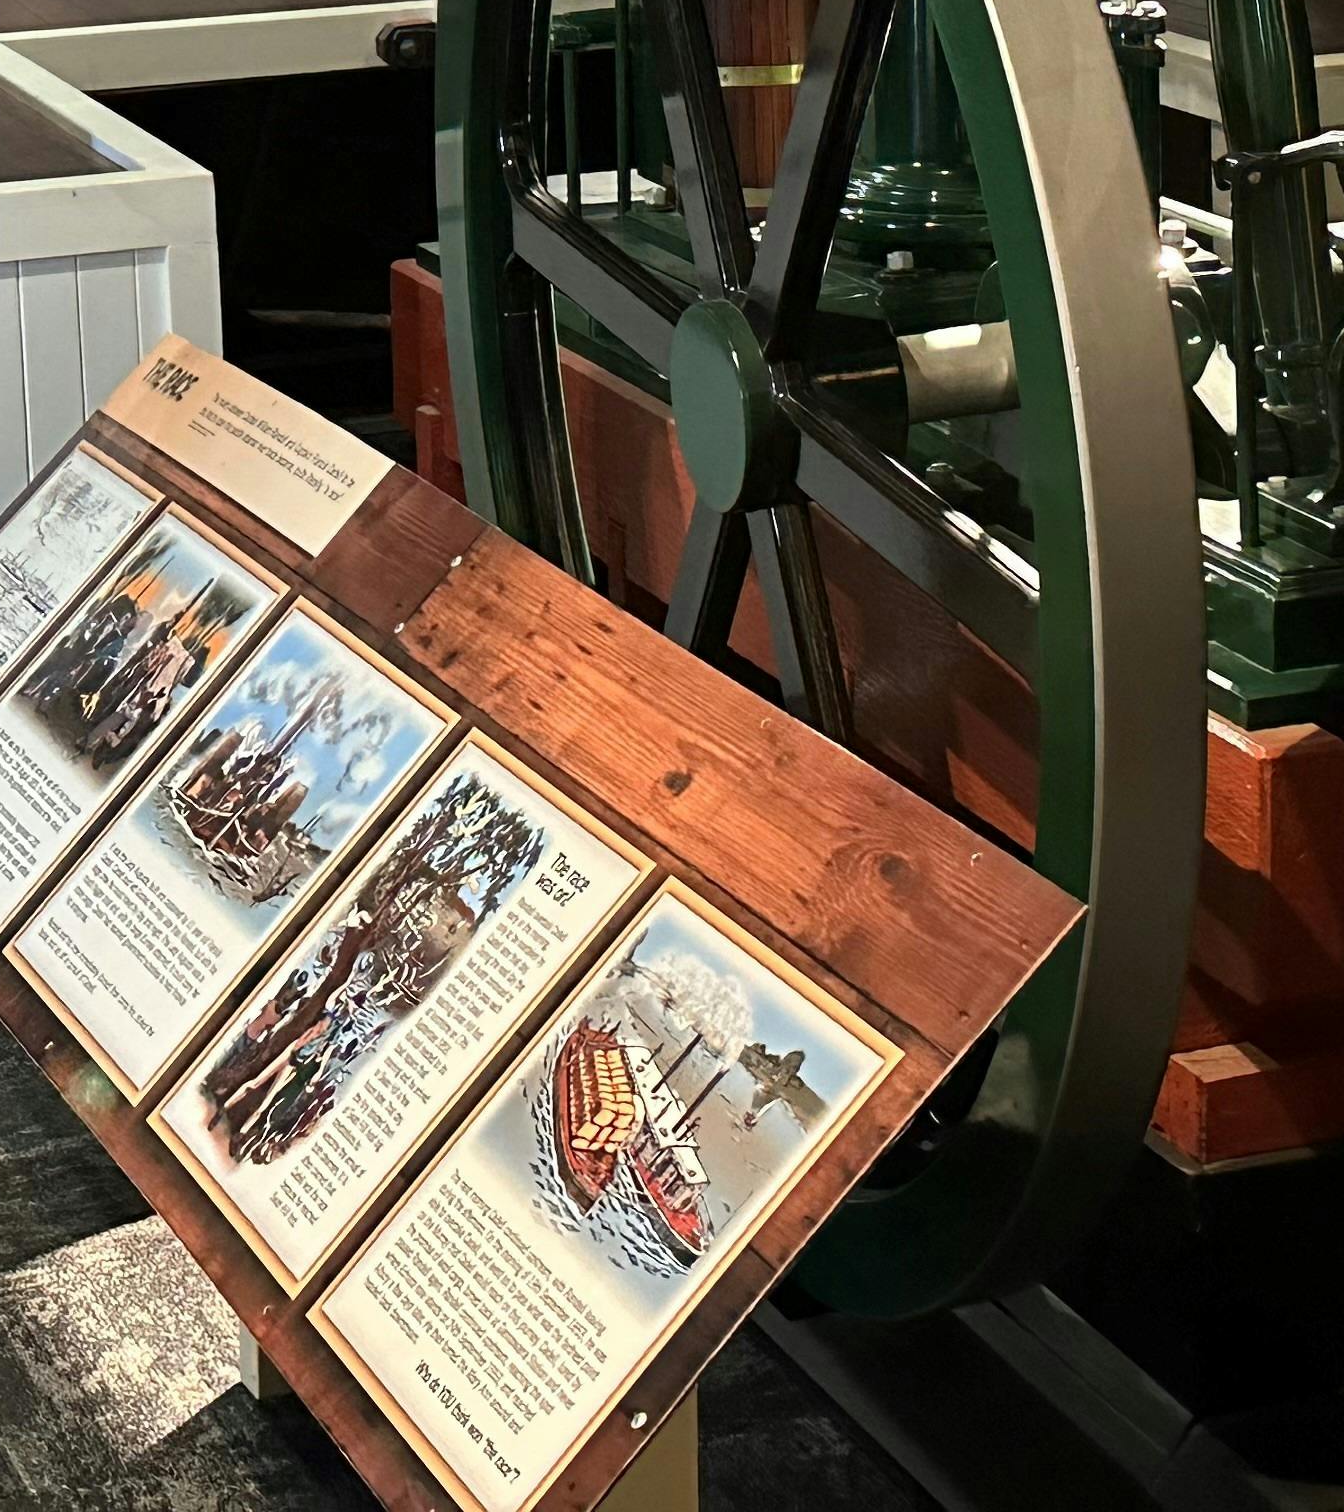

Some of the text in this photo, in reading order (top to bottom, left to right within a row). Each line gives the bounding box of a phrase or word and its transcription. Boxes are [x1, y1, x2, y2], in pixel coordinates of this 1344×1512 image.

[142, 357, 199, 402] THE RACE
[534, 872, 557, 895] was
[550, 851, 590, 893] The race
[437, 1384, 456, 1409] YOU
